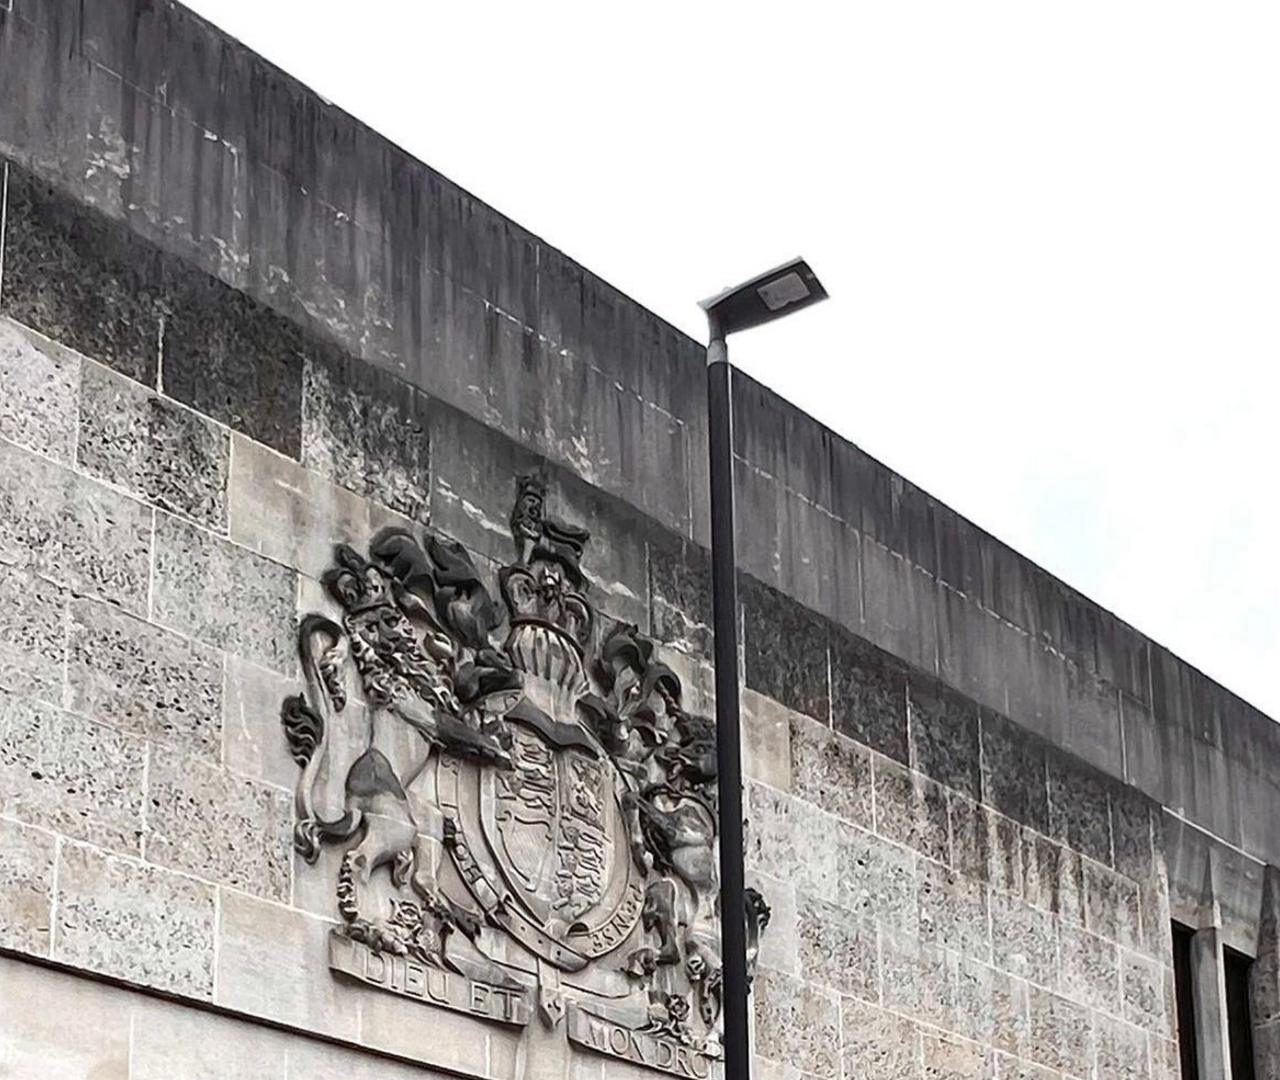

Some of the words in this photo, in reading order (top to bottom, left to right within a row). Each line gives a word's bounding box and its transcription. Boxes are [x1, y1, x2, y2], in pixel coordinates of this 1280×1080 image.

[364, 949, 450, 1004] DIEU
[471, 980, 522, 1020] ET
[584, 1018, 650, 1063] MON
